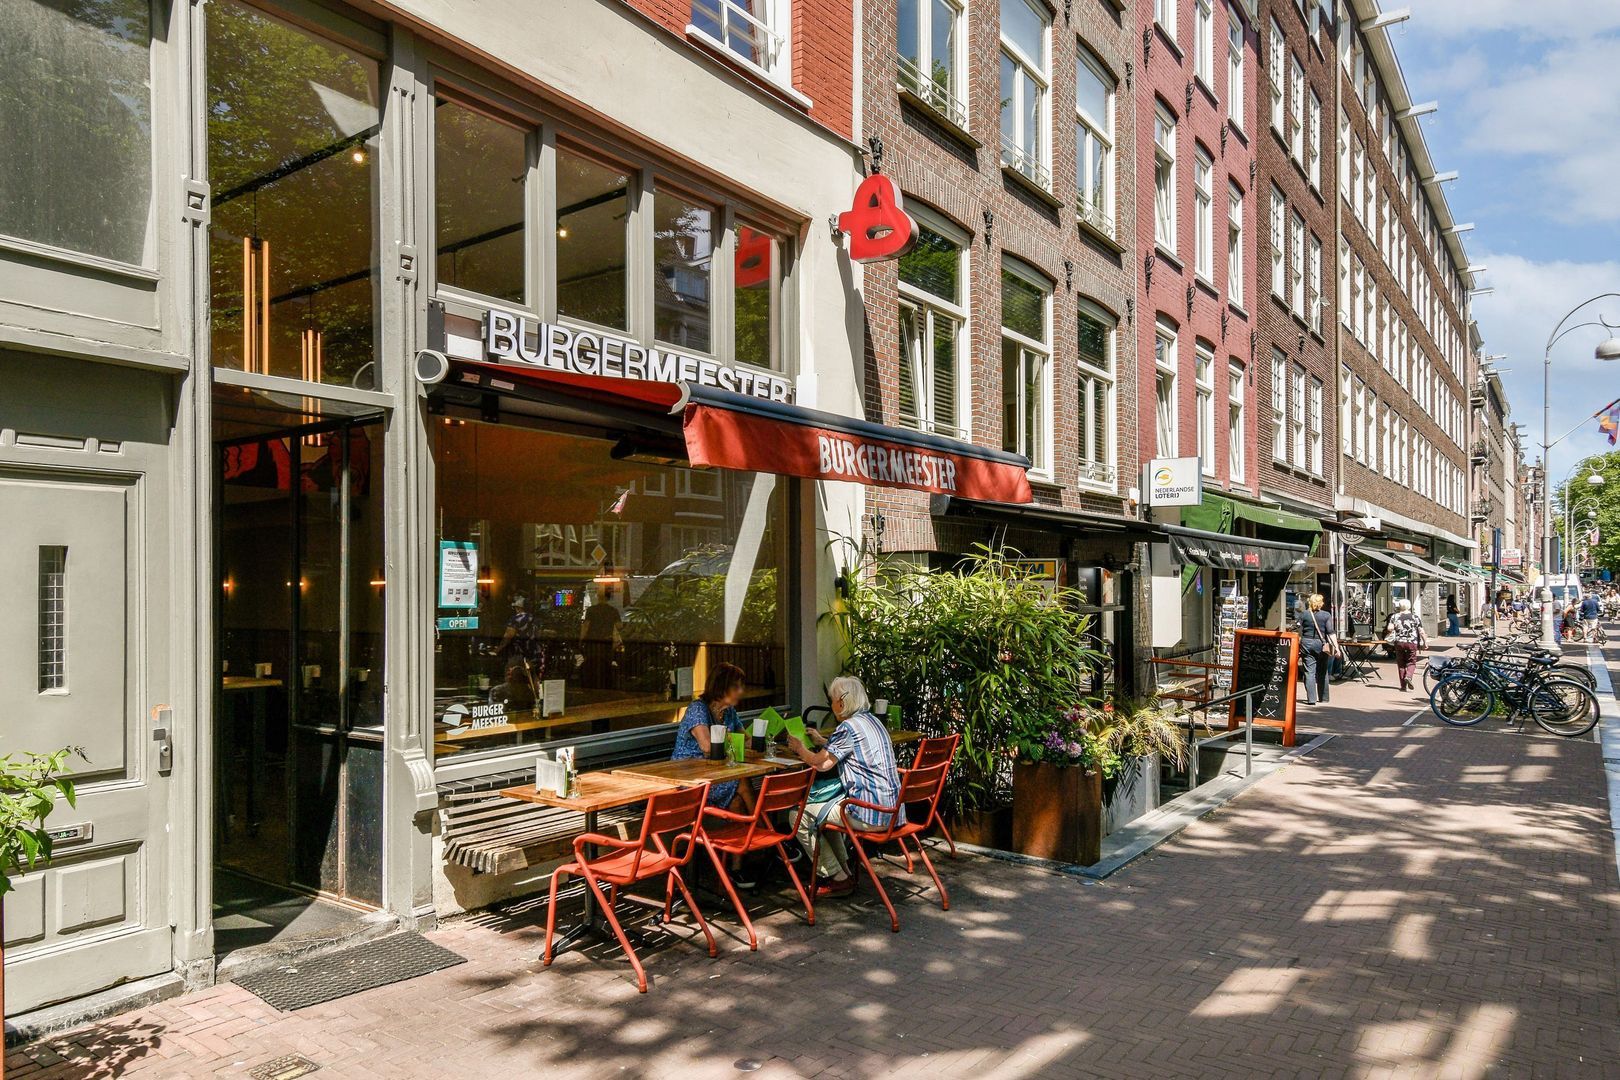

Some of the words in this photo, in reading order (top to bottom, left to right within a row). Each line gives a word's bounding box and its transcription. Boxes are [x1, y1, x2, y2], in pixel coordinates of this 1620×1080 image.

[487, 309, 788, 404] BURGERMEESTER
[818, 435, 957, 491] BURGERMEESTER
[1154, 486, 1195, 494] NEDERLANDSE
[448, 619, 468, 628] OPEN
[472, 703, 504, 718] BURGER
[471, 715, 508, 731] MEESTER
